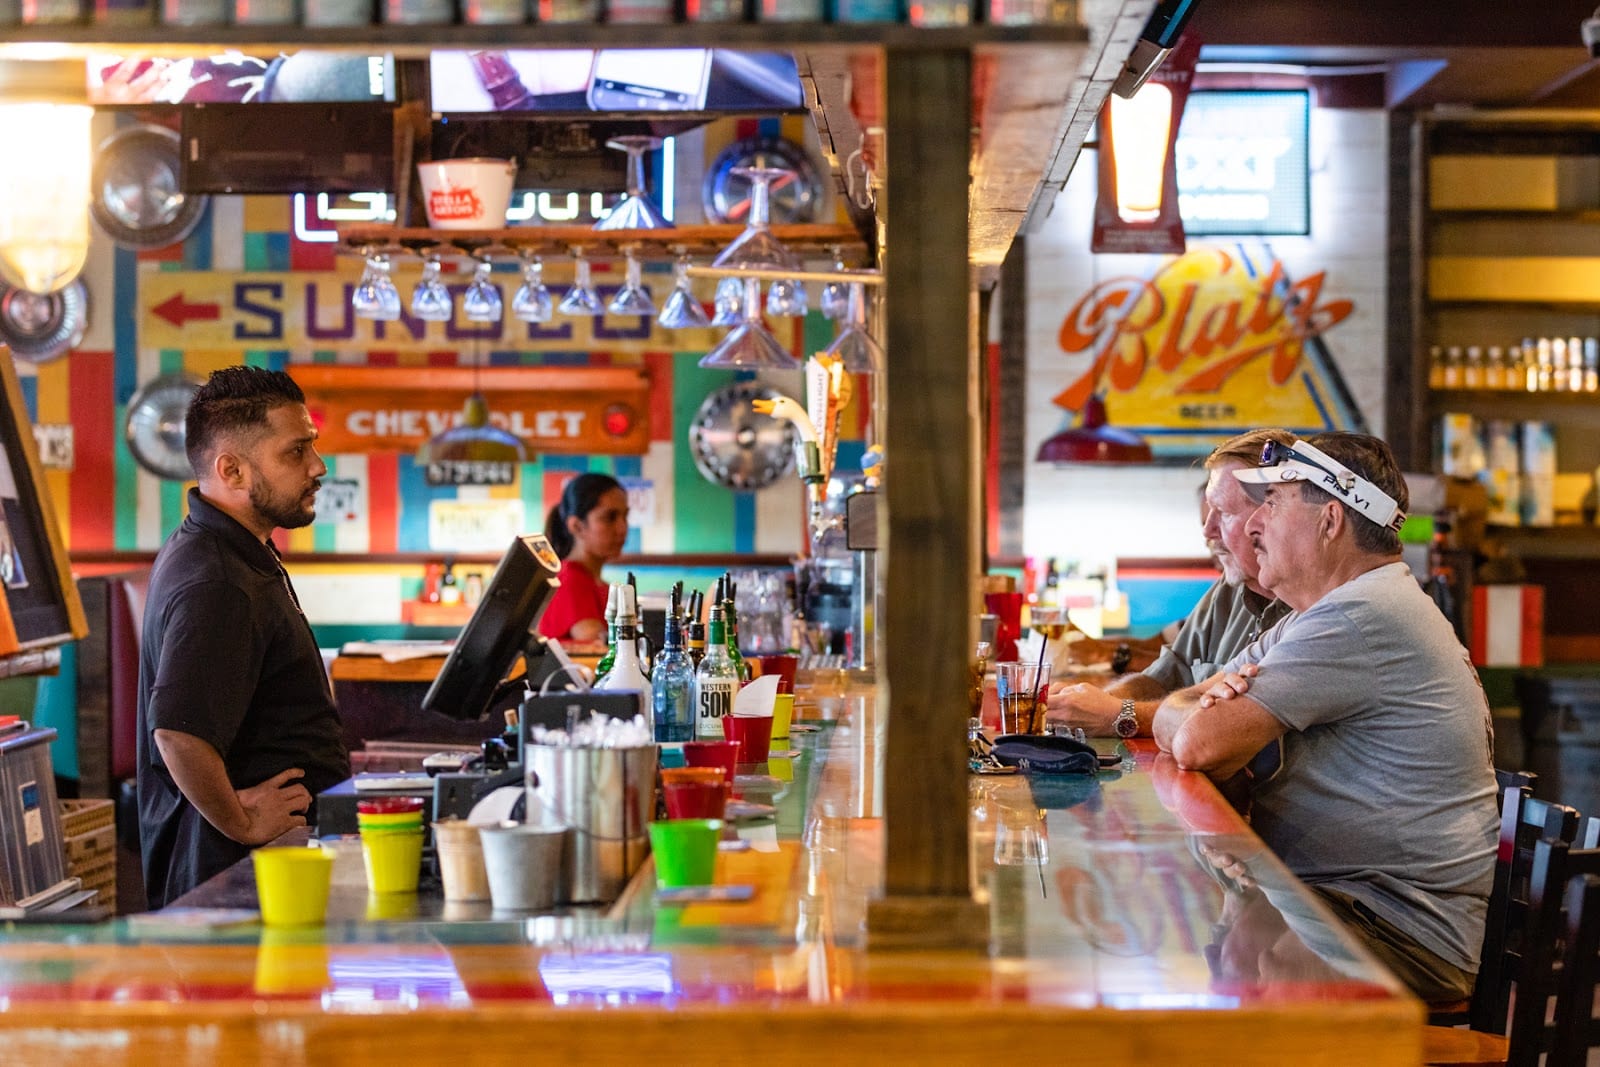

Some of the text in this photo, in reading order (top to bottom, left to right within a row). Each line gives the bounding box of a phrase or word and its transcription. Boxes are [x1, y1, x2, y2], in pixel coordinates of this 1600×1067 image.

[1052, 260, 1354, 410] Blatz
[1179, 404, 1236, 419] BEER
[346, 410, 586, 437] CHEVOLET
[1354, 494, 1370, 510] V1
[701, 683, 731, 691] WESTERN
[701, 691, 731, 719] SON
